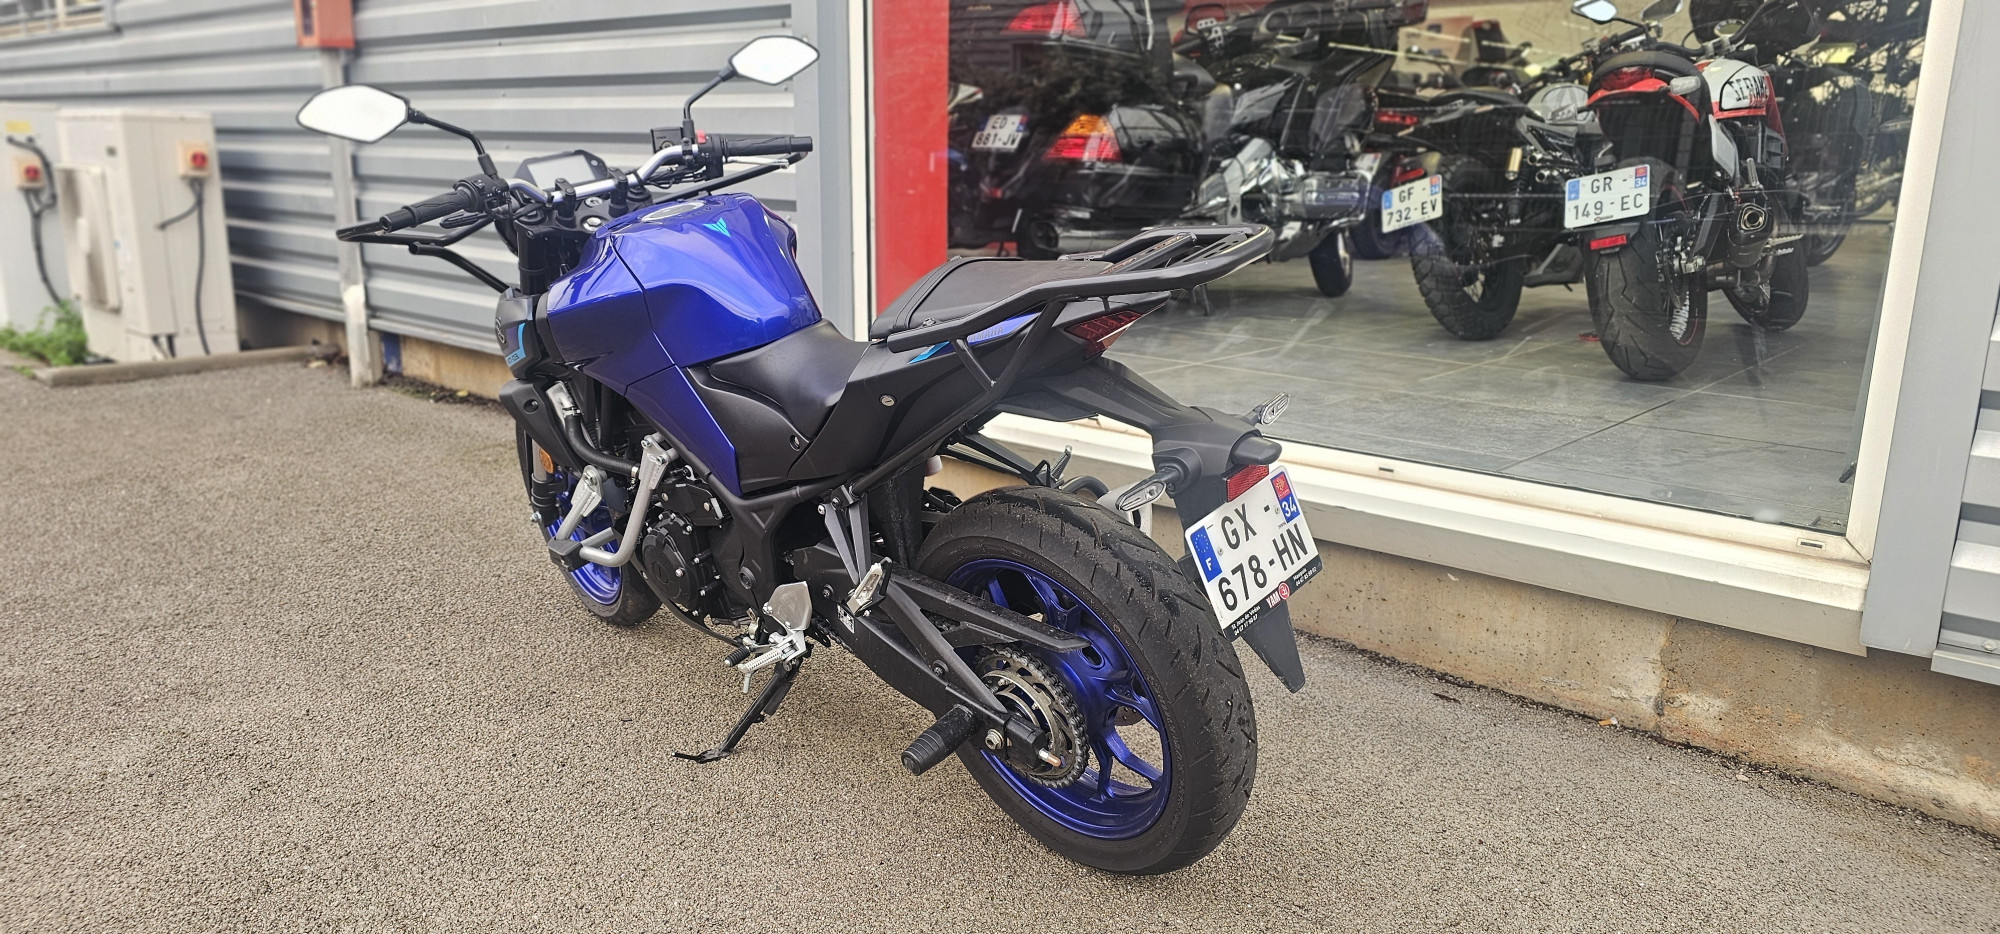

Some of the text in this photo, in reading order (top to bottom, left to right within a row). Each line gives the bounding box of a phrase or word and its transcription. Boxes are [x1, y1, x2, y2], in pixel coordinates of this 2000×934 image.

[1590, 176, 1612, 194] GR
[1635, 176, 1647, 187] 34
[1398, 186, 1415, 204] GF
[1386, 198, 1437, 226] 732-EV
[1573, 193, 1643, 220] 149-EC
[969, 326, 1004, 342] AMAHA
[1281, 496, 1297, 518] 34
[1221, 502, 1258, 550] GX
[1205, 557, 1212, 572] F
[1218, 522, 1309, 612] 678-HN
[1265, 590, 1281, 609] YAM
